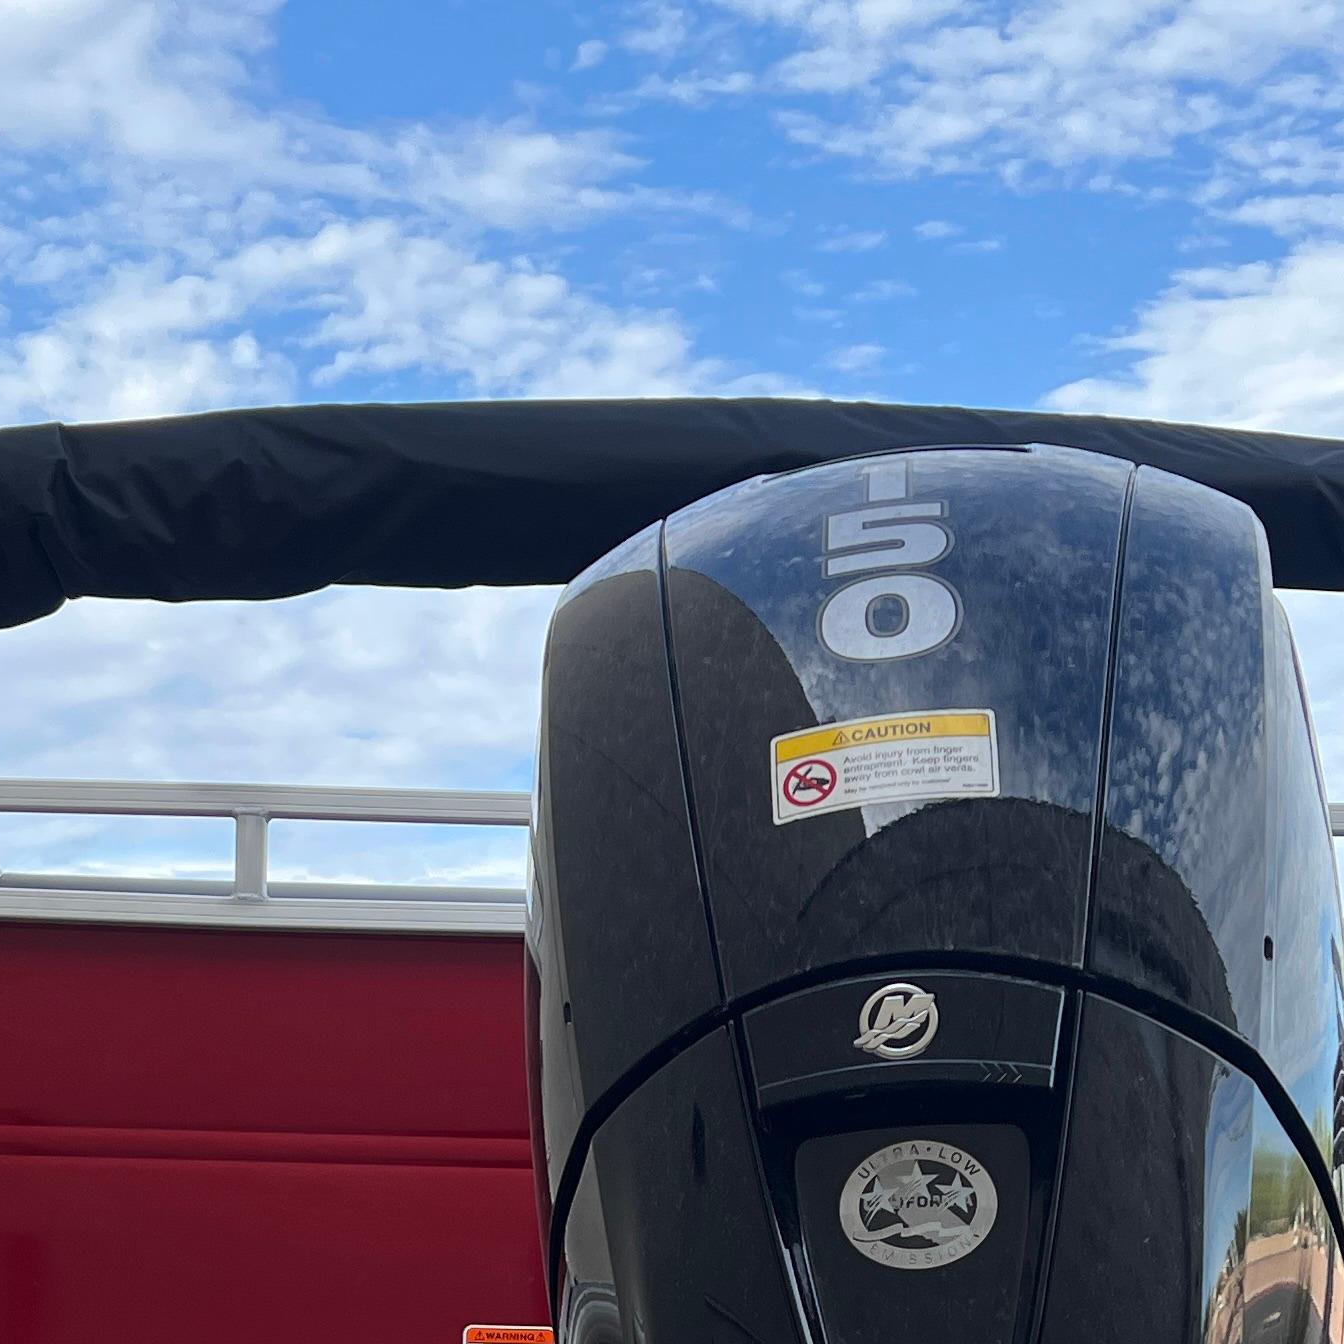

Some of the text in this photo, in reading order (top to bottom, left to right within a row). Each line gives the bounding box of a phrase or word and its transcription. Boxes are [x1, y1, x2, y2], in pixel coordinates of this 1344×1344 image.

[852, 721, 931, 741] CAUTION
[843, 745, 963, 764] Avoid injury from finger
[912, 756, 940, 766] Keep
[943, 754, 979, 765] fingers
[844, 773, 872, 784] away
[874, 770, 898, 779] from
[928, 765, 941, 774] air
[939, 1146, 981, 1176] LOW
[485, 1332, 535, 1341] WARNING
